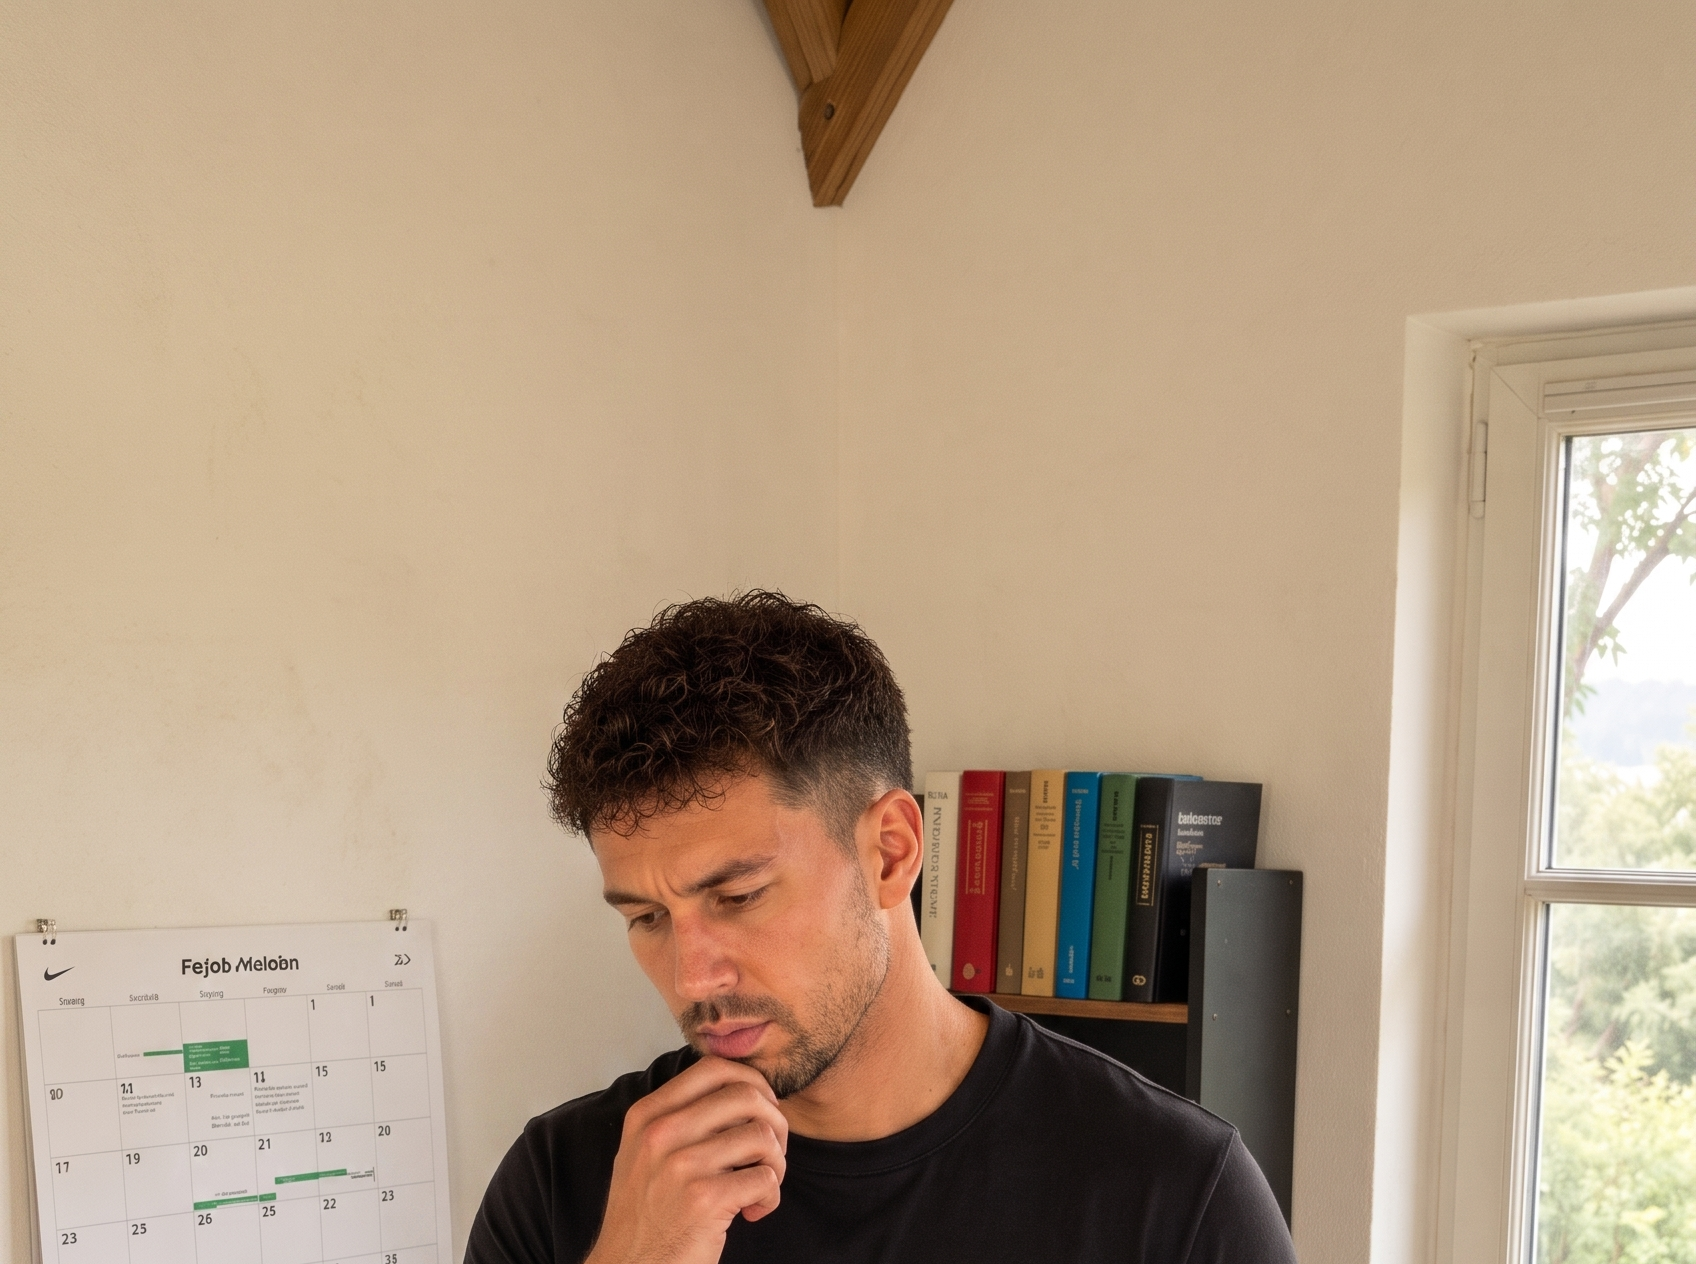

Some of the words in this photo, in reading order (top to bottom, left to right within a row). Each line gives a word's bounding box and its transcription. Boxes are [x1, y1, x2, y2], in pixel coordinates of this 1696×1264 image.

[182, 958, 231, 978] Fejob
[310, 999, 315, 1010] 1
[370, 995, 375, 1006] 1
[316, 1066, 328, 1077] 15
[374, 1060, 386, 1072] 15
[189, 1076, 201, 1088] 13
[378, 1125, 391, 1136] 20
[258, 1138, 271, 1150] 21
[193, 1145, 208, 1157] 20
[126, 1153, 140, 1165] 19
[56, 1162, 69, 1174] 17
[381, 1190, 394, 1202] 23
[323, 1198, 336, 1210] 22
[262, 1206, 276, 1217] 25
[197, 1213, 212, 1226] 26
[131, 1223, 147, 1235] 25
[61, 1232, 77, 1245] 23
[385, 1253, 398, 1264] 35
